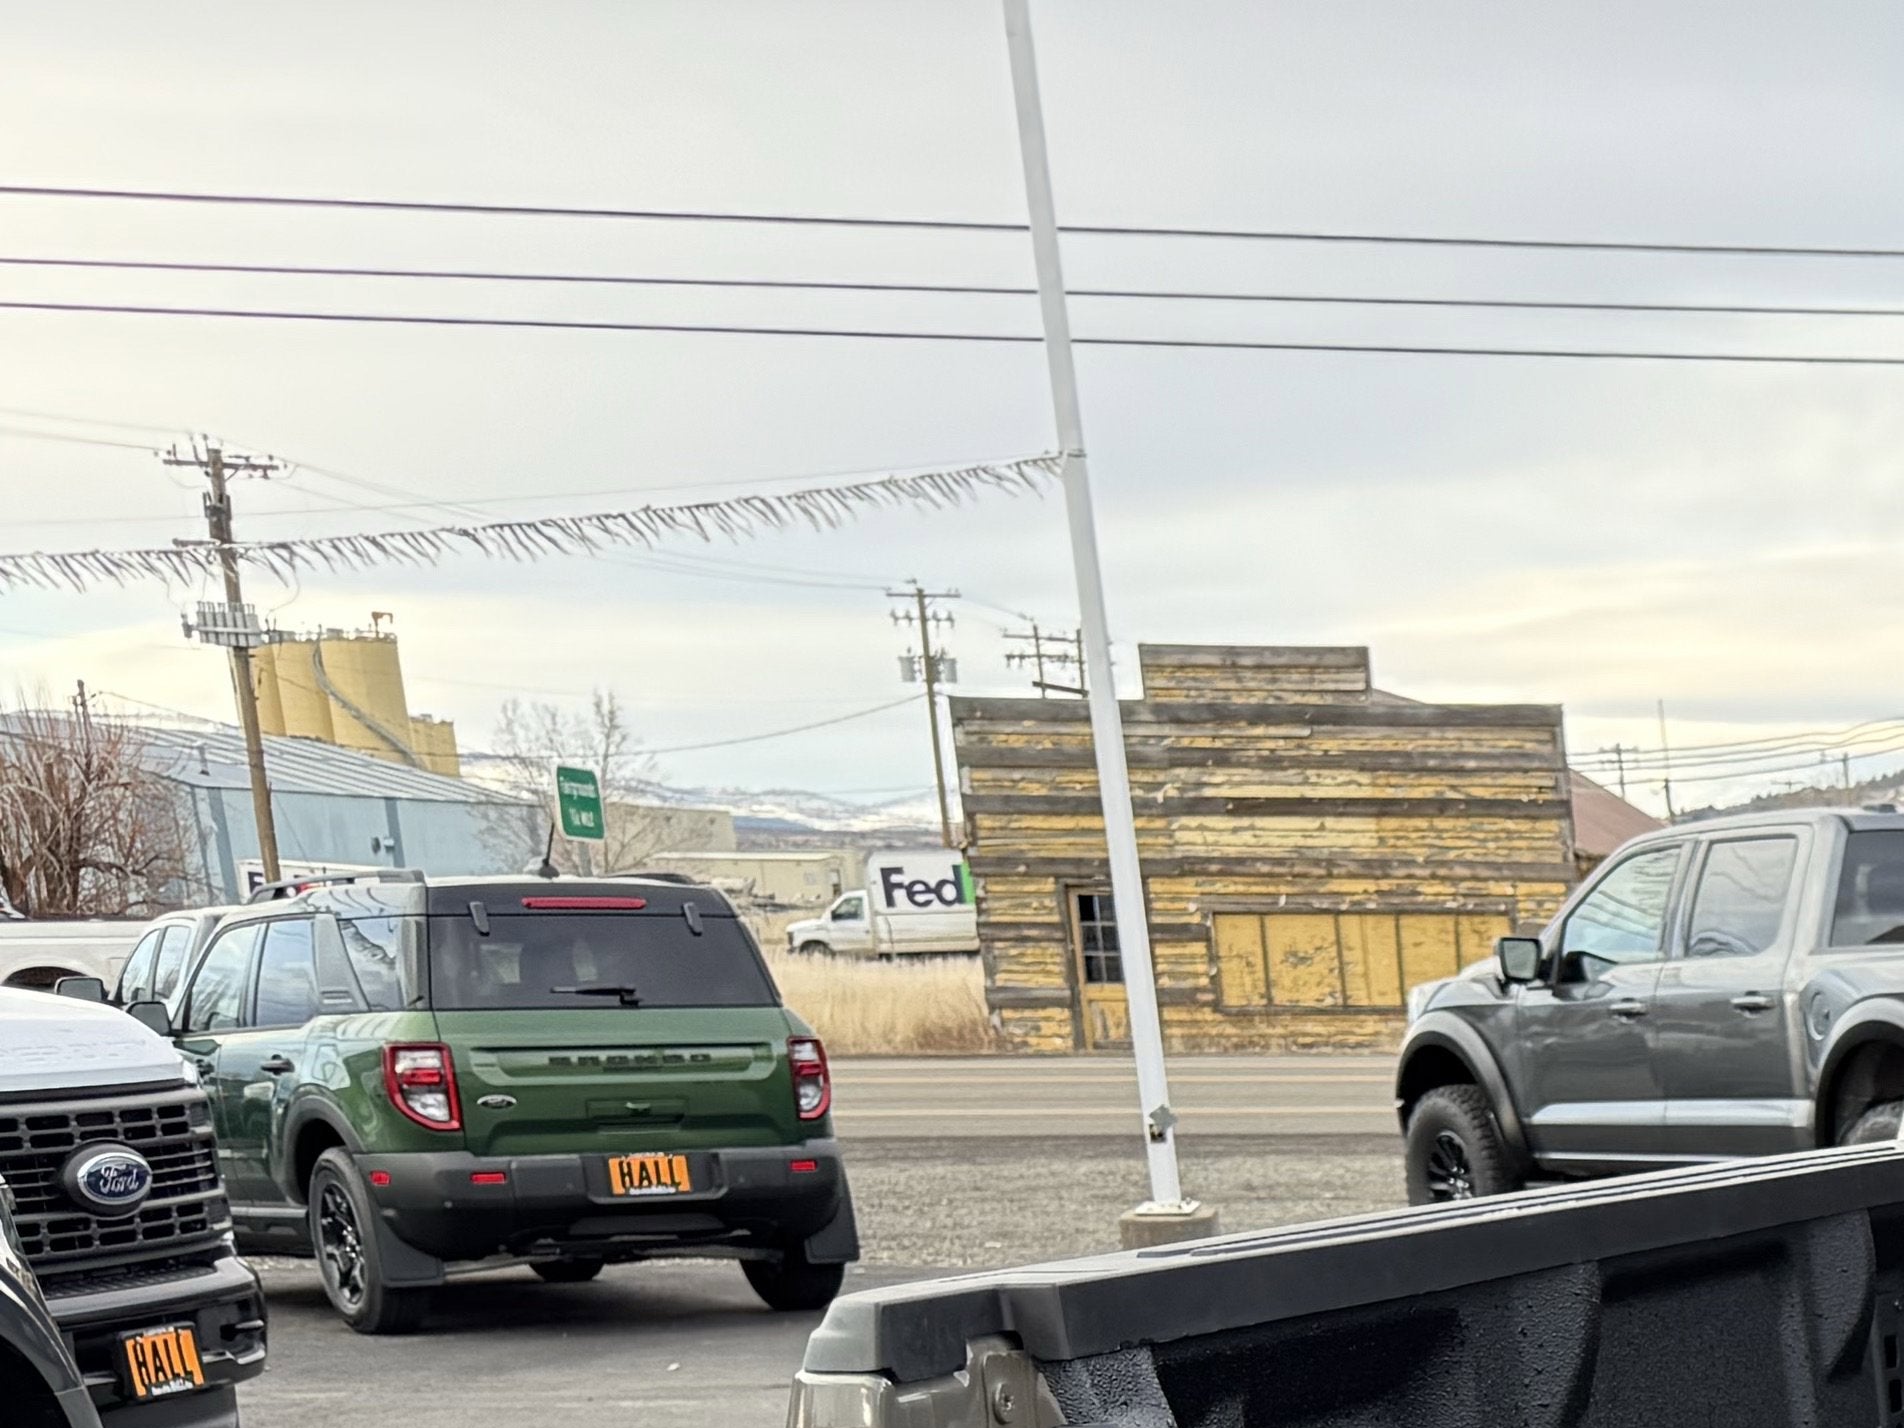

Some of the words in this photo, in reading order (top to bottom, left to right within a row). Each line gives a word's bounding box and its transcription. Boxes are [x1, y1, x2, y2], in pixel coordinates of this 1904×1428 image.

[880, 863, 975, 908] Fed
[99, 1163, 139, 1195] Ford
[618, 1157, 682, 1190] HALL
[132, 1332, 194, 1390] HALL
